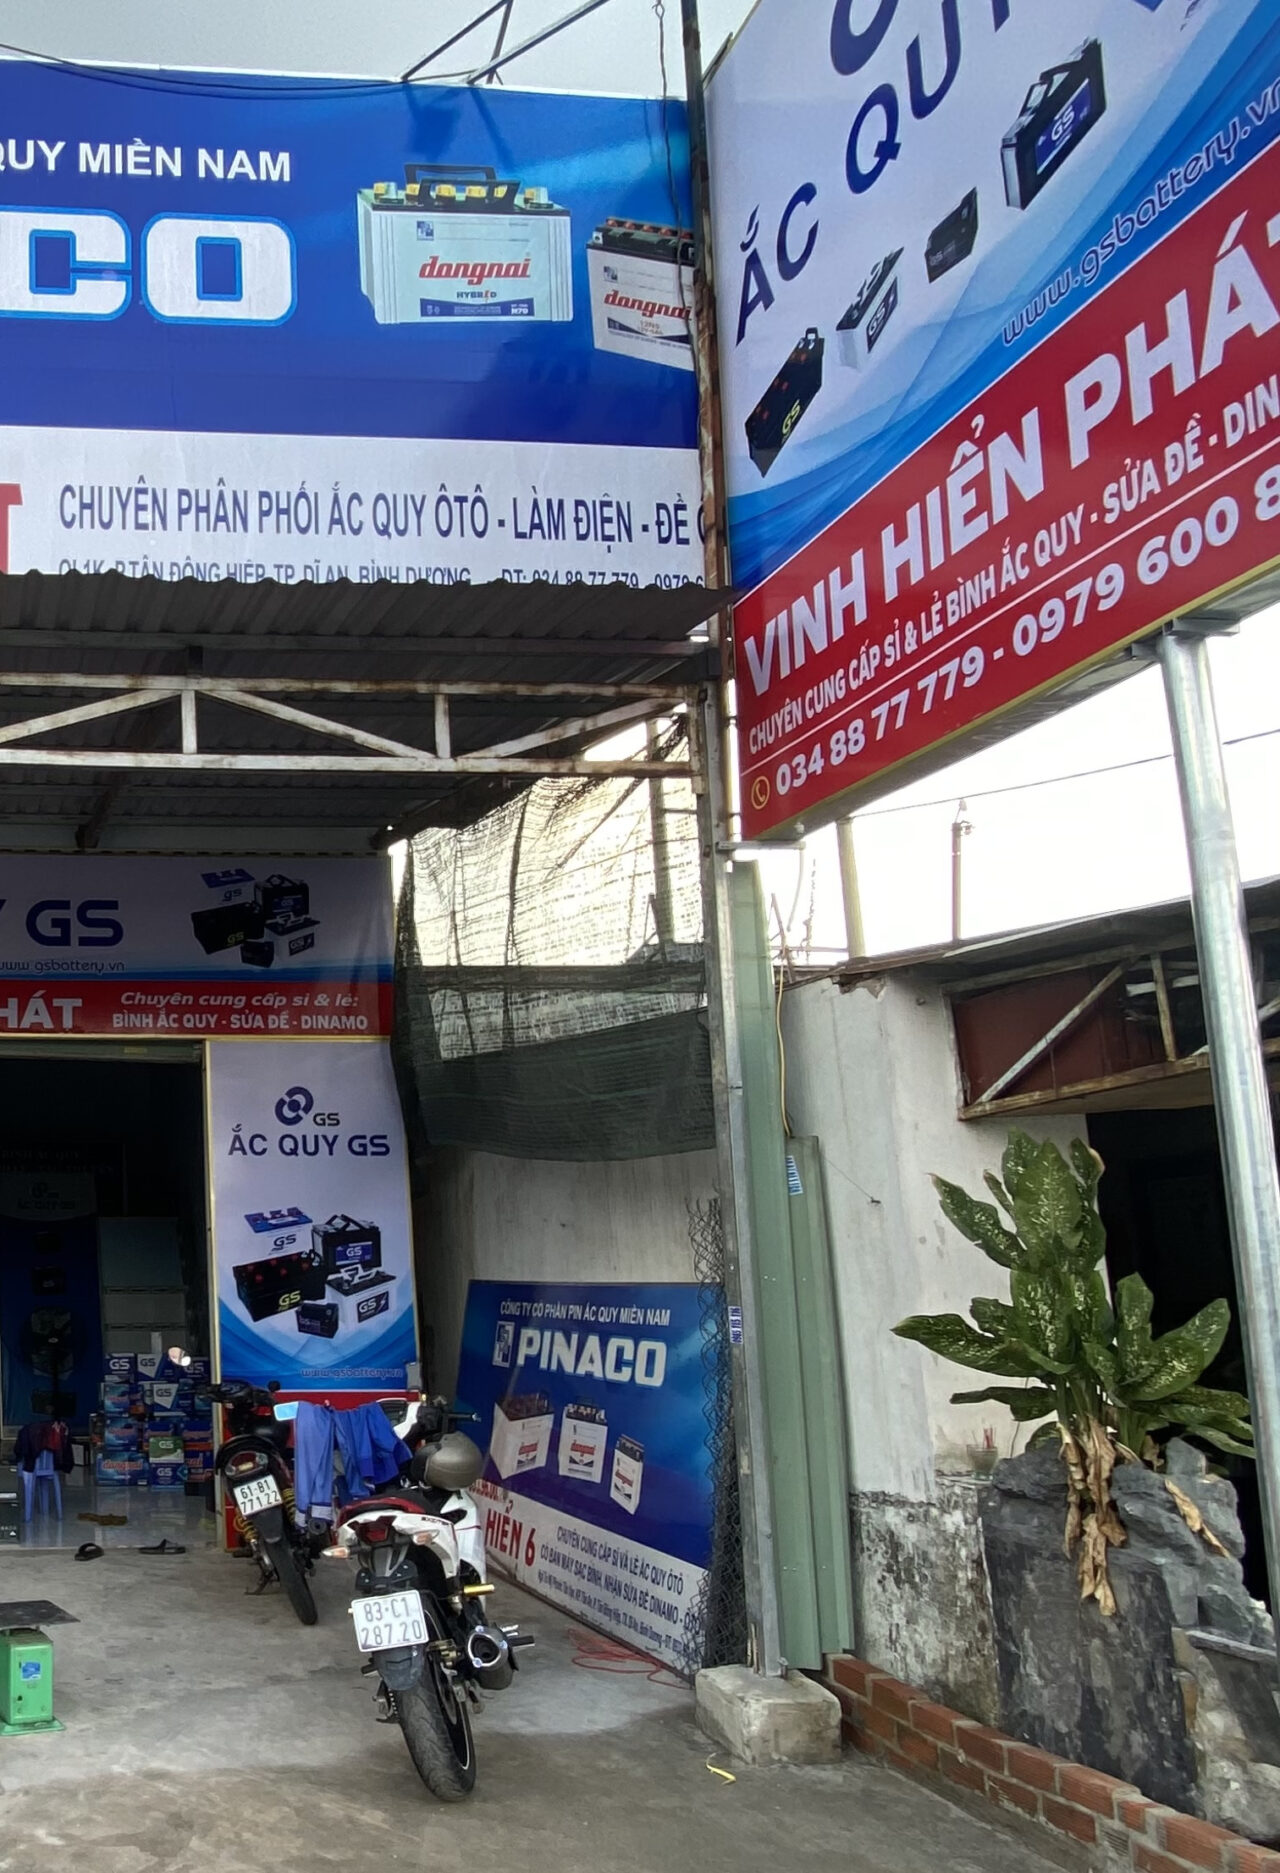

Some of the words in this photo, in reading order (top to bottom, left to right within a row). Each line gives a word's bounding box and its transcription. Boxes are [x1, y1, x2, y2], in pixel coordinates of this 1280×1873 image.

[78, 138, 182, 178] MIỀN
[196, 147, 291, 182] NAM
[735, 182, 819, 347] ẮC
[845, 0, 1011, 195] QU
[60, 475, 167, 531] CHUYÊN
[177, 478, 248, 533] PHÂN
[258, 481, 319, 535] PHỐI
[328, 481, 364, 535] ẮC
[373, 493, 426, 539] QUY
[435, 483, 489, 538] ÔTÔ
[513, 485, 566, 541] LÀM
[574, 492, 633, 553] ĐIỆN
[655, 492, 690, 545] ĐỀ
[743, 549, 868, 697] VINH
[881, 408, 1045, 603] HIỂN
[749, 695, 803, 755] CHUYÊN
[803, 667, 847, 715] CUNG
[848, 638, 881, 692] CẤP
[884, 619, 902, 668] SỈ
[903, 625, 918, 655] &
[920, 591, 943, 646] LẺ
[946, 565, 997, 632] BÌNH
[1000, 538, 1030, 594] ẮC
[1034, 504, 1084, 568] QUY
[1103, 459, 1162, 524] SỬA
[1164, 413, 1204, 488] ĐỀ
[775, 746, 824, 797] 034
[829, 718, 866, 767] 88
[870, 690, 913, 740] 77
[916, 651, 985, 714] 779
[1012, 563, 1124, 657] 0979
[1136, 496, 1239, 586] 600
[25, 900, 124, 947] GS
[121, 991, 194, 1007] Chuyên
[199, 995, 245, 1010] cung
[315, 993, 330, 1007] &
[112, 1010, 153, 1028] BÌNH
[183, 1014, 217, 1030] QUY
[300, 1015, 368, 1030] DINAMO
[313, 1113, 340, 1127] GS
[228, 1124, 267, 1156] ẮC
[278, 1135, 339, 1157] QUY
[348, 1135, 390, 1156] GS
[273, 1235, 296, 1248] GS
[359, 1299, 377, 1314] GS
[522, 1303, 531, 1316] TY
[569, 1305, 581, 1320] PIN
[598, 1307, 617, 1323] QUY
[646, 1309, 670, 1326] NAM
[109, 1359, 130, 1370] GS
[140, 1358, 155, 1367] GS
[517, 1328, 667, 1387] PINACO
